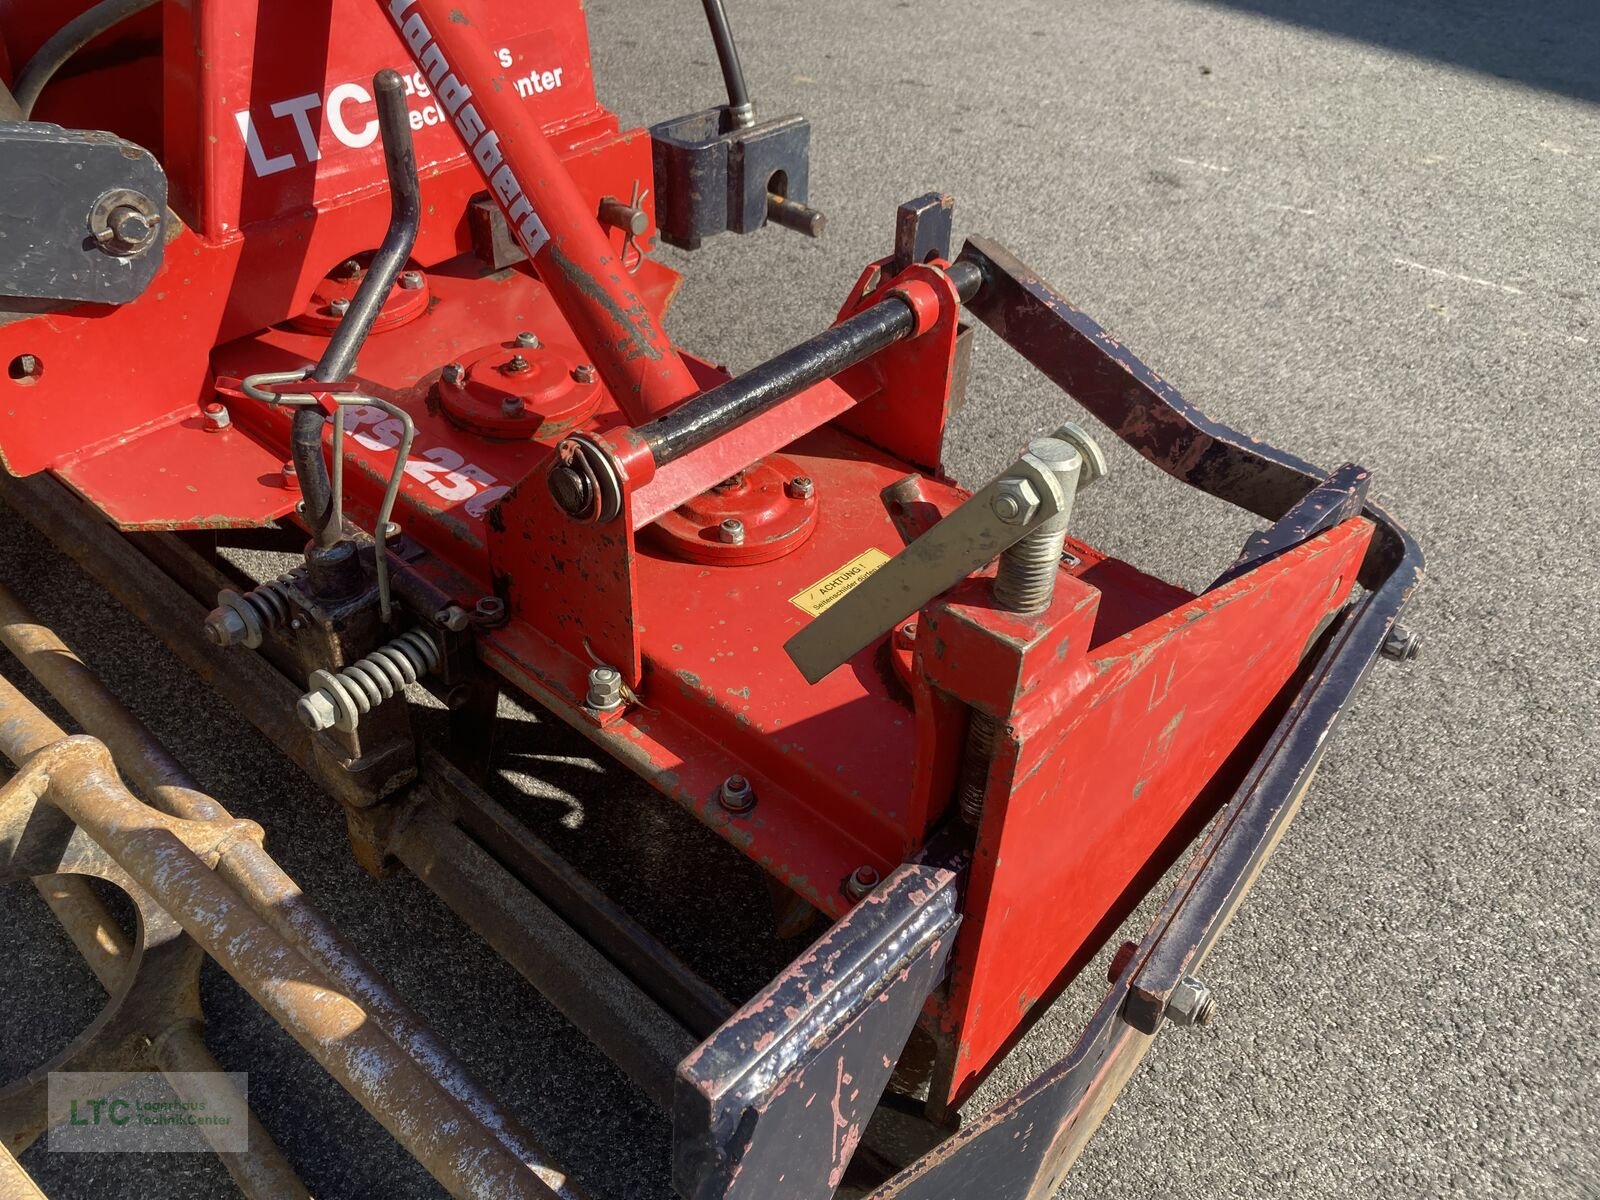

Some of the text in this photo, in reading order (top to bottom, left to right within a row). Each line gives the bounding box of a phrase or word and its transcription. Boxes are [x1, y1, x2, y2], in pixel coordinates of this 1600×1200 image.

[235, 83, 379, 178] LTC
[813, 581, 857, 610] Seitenschilder
[819, 567, 861, 595] ACHTUNG
